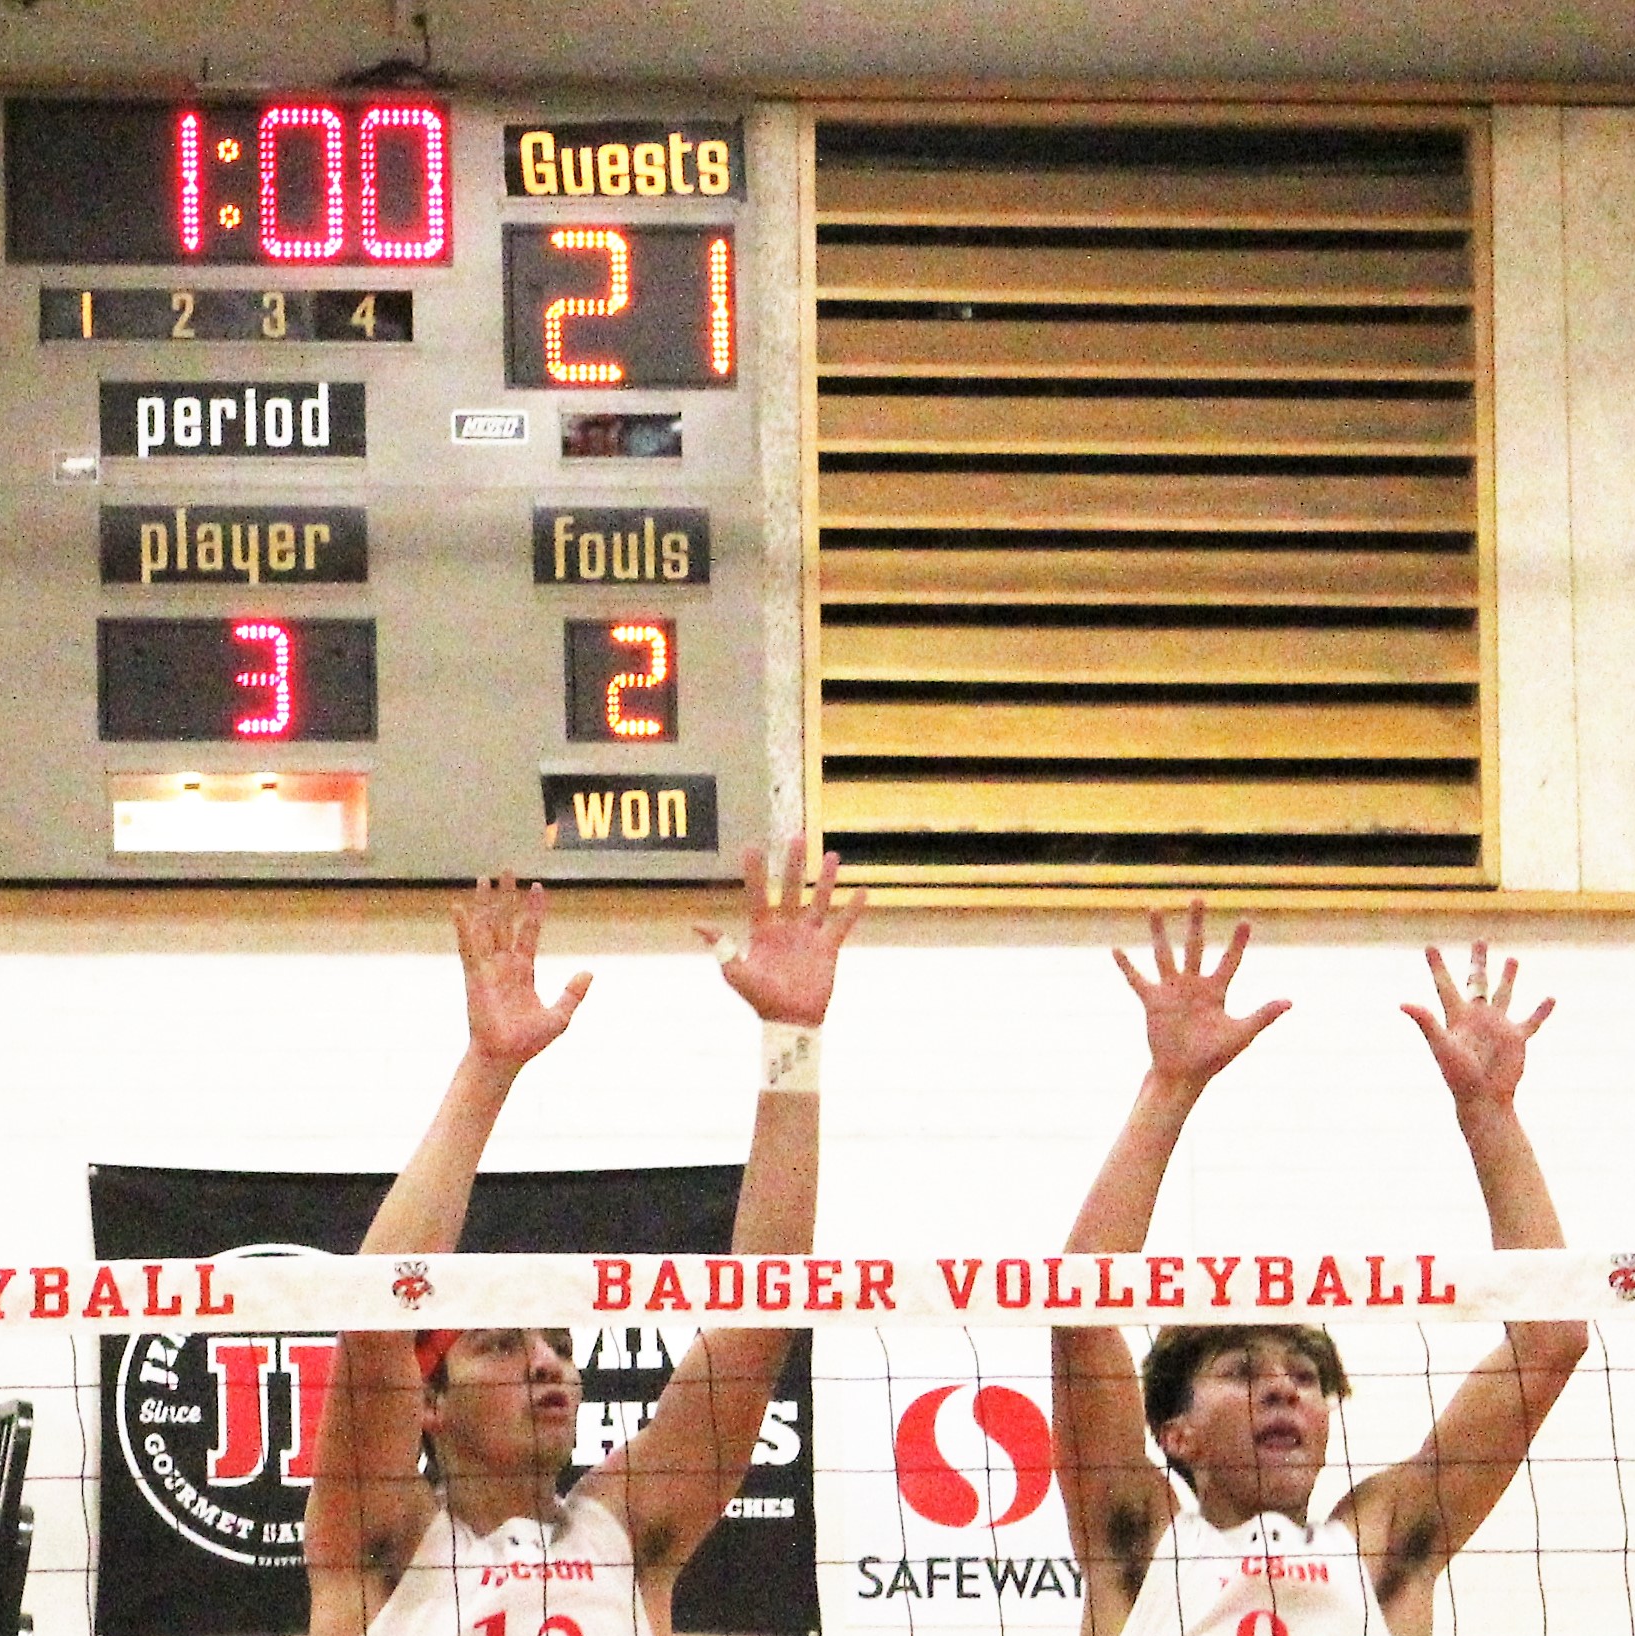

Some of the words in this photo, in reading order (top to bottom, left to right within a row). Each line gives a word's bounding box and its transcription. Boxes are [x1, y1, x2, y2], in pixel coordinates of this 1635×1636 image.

[180, 106, 444, 261] 1:00
[519, 131, 732, 199] Guests
[79, 291, 95, 339] 1
[171, 291, 196, 339] 2
[263, 291, 287, 339] 3
[350, 290, 377, 338] 4
[543, 227, 731, 385] 21
[135, 382, 332, 458] period
[139, 510, 331, 586] player
[553, 517, 690, 581] fouls
[234, 621, 290, 736] 3
[608, 624, 669, 739] 2
[574, 786, 690, 841] won
[590, 1259, 897, 1311] BADGER
[935, 1254, 1457, 1309] VOLLEYBALL
[139, 1398, 202, 1424] Since
[722, 1497, 795, 1519] CHES
[858, 1556, 1086, 1600] SAFEWAY
